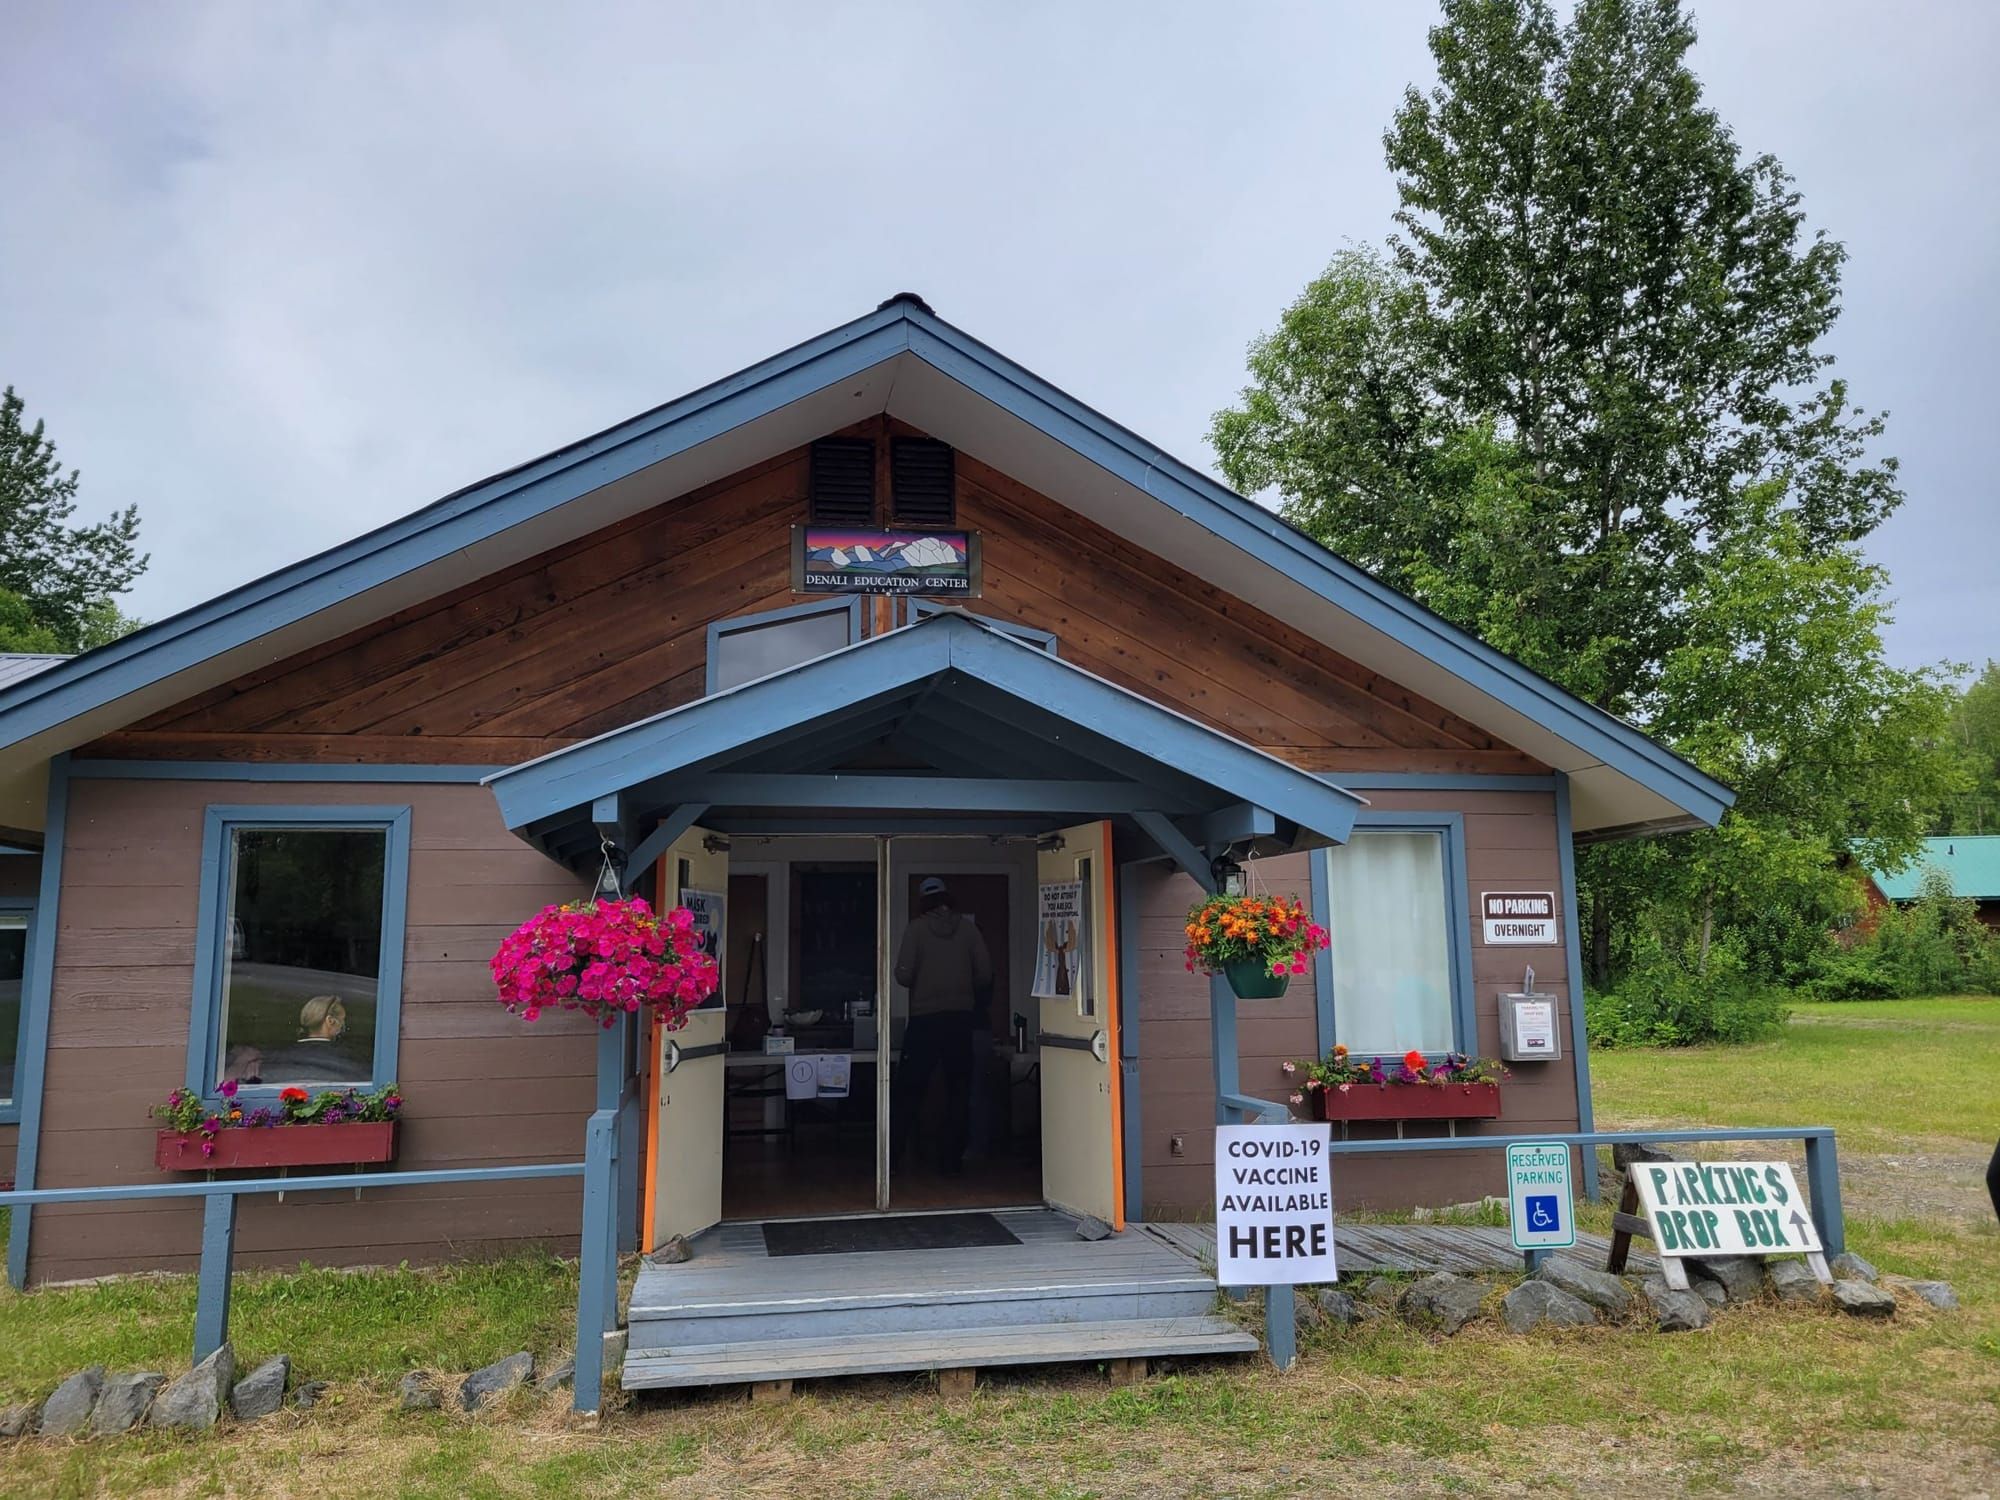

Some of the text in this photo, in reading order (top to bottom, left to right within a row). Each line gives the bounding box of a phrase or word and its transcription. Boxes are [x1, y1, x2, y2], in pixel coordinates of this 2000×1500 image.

[806, 575, 968, 588] DENALI EDUCATION CENTER
[1488, 898, 1548, 914] NO PARKING
[1494, 924, 1546, 937] OVERNIGHT
[1228, 1140, 1321, 1158] COVID-19
[1511, 1153, 1565, 1167] RESERVED
[1232, 1166, 1318, 1185] VACCINE
[1516, 1171, 1563, 1184] PARKING
[1221, 1193, 1328, 1212] AVAILABLE
[1655, 1209, 1790, 1249] DROP BOX
[1229, 1223, 1327, 1259] HERE
